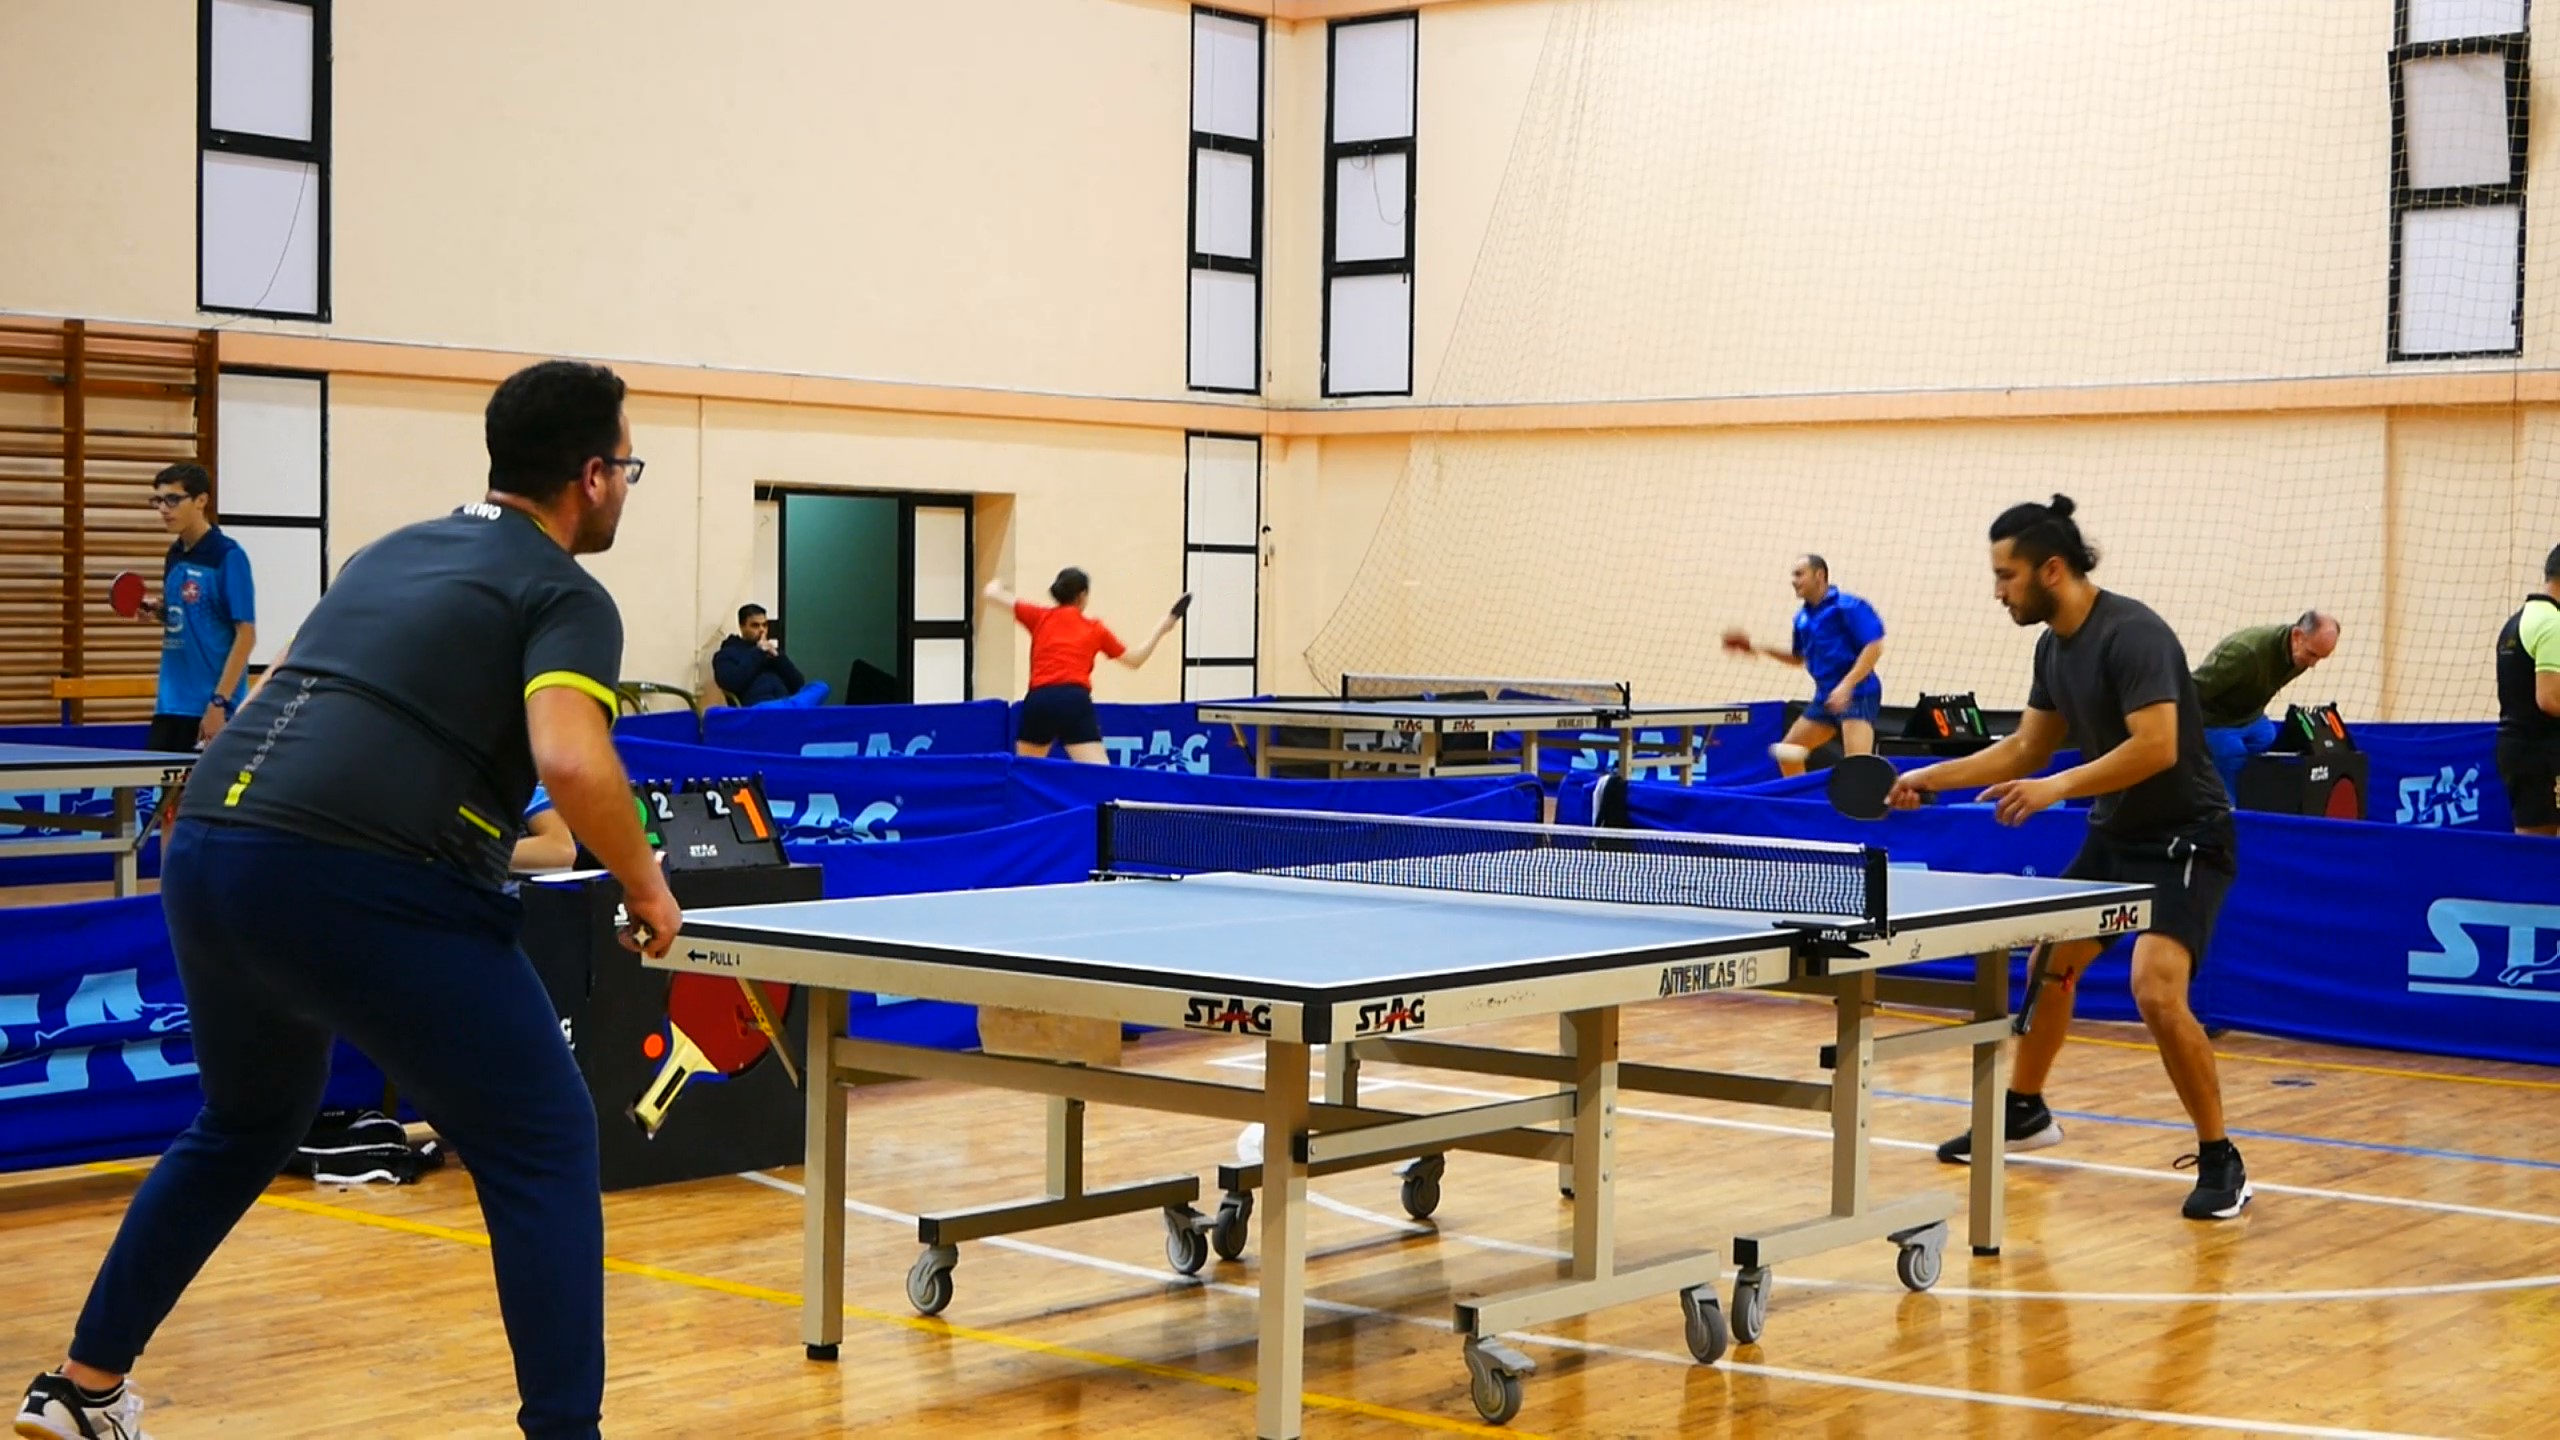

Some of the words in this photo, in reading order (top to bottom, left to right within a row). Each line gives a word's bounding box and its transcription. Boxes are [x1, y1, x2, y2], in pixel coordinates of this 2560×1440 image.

[651, 791, 674, 819] 2
[706, 790, 731, 815] 2
[732, 788, 769, 838] 1
[2099, 905, 2138, 931] STAG
[709, 950, 733, 966] PULL
[1659, 960, 1737, 997] AMERICAS
[1738, 956, 1758, 986] 16
[1184, 997, 1272, 1036] STAG
[1356, 996, 1425, 1036] STAG
